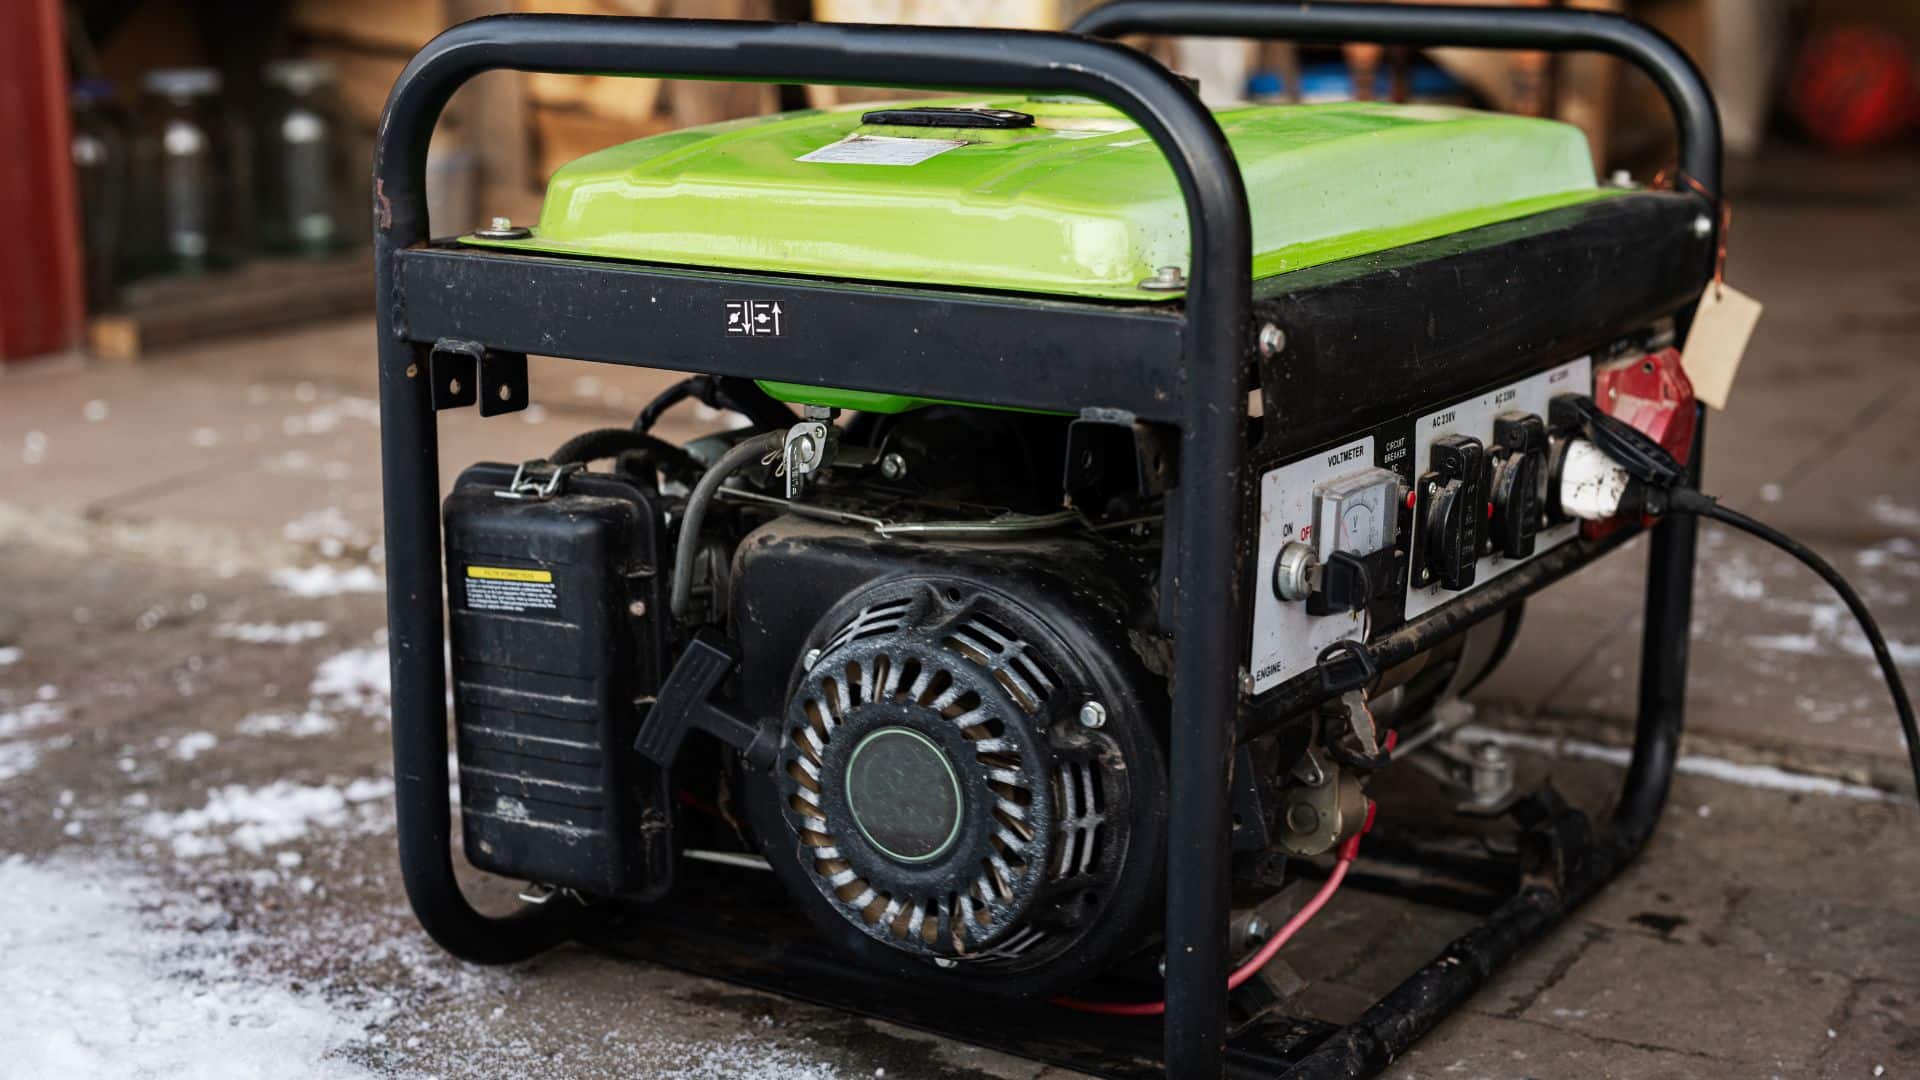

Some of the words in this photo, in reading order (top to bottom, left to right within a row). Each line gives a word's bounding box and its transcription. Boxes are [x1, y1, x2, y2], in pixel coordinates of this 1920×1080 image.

[1432, 416, 1441, 428] AC
[1442, 410, 1456, 425] 230V
[1385, 437, 1406, 452] CIRCUIT
[1327, 445, 1364, 467] VOLTMETER
[1384, 448, 1406, 464] BREAKER
[1283, 523, 1293, 537] ON
[1256, 660, 1281, 682] ENGINE
